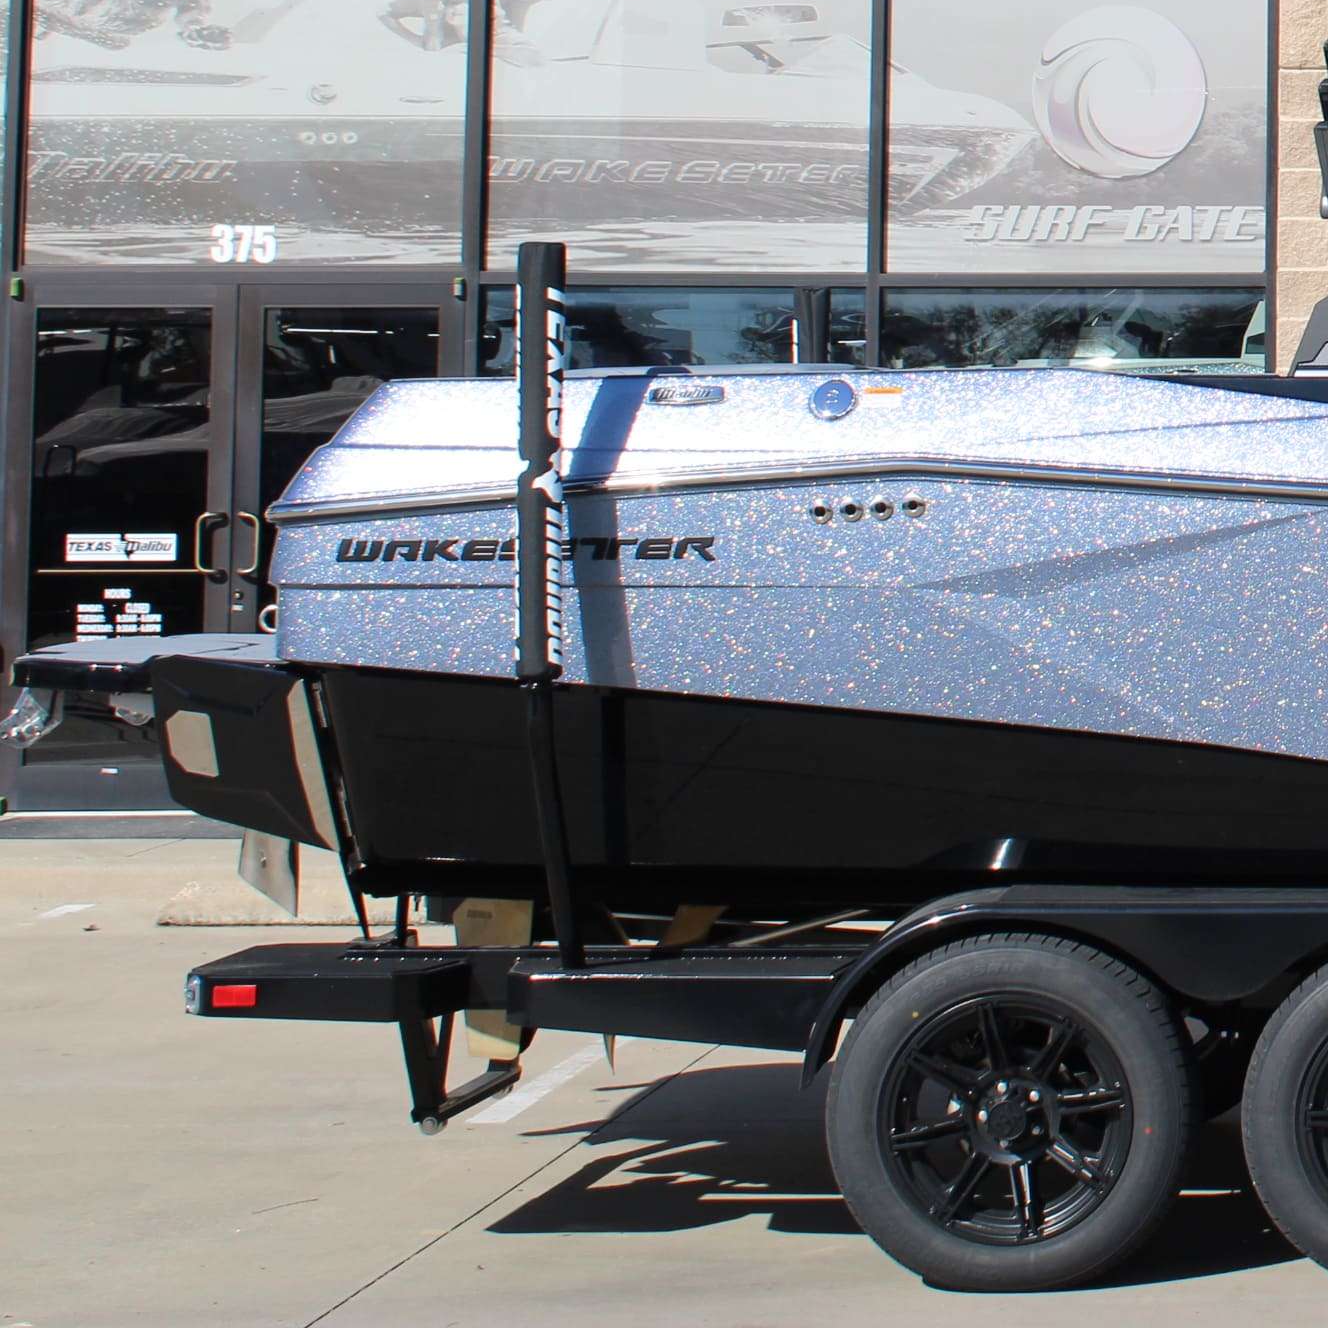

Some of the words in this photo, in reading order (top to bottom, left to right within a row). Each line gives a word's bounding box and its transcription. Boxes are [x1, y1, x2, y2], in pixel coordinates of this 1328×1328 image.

[963, 205, 1114, 242] SURF
[1122, 205, 1266, 242] GATE
[210, 223, 278, 264] 375
[68, 541, 113, 553] TEXAS
[124, 540, 173, 553] Malibu
